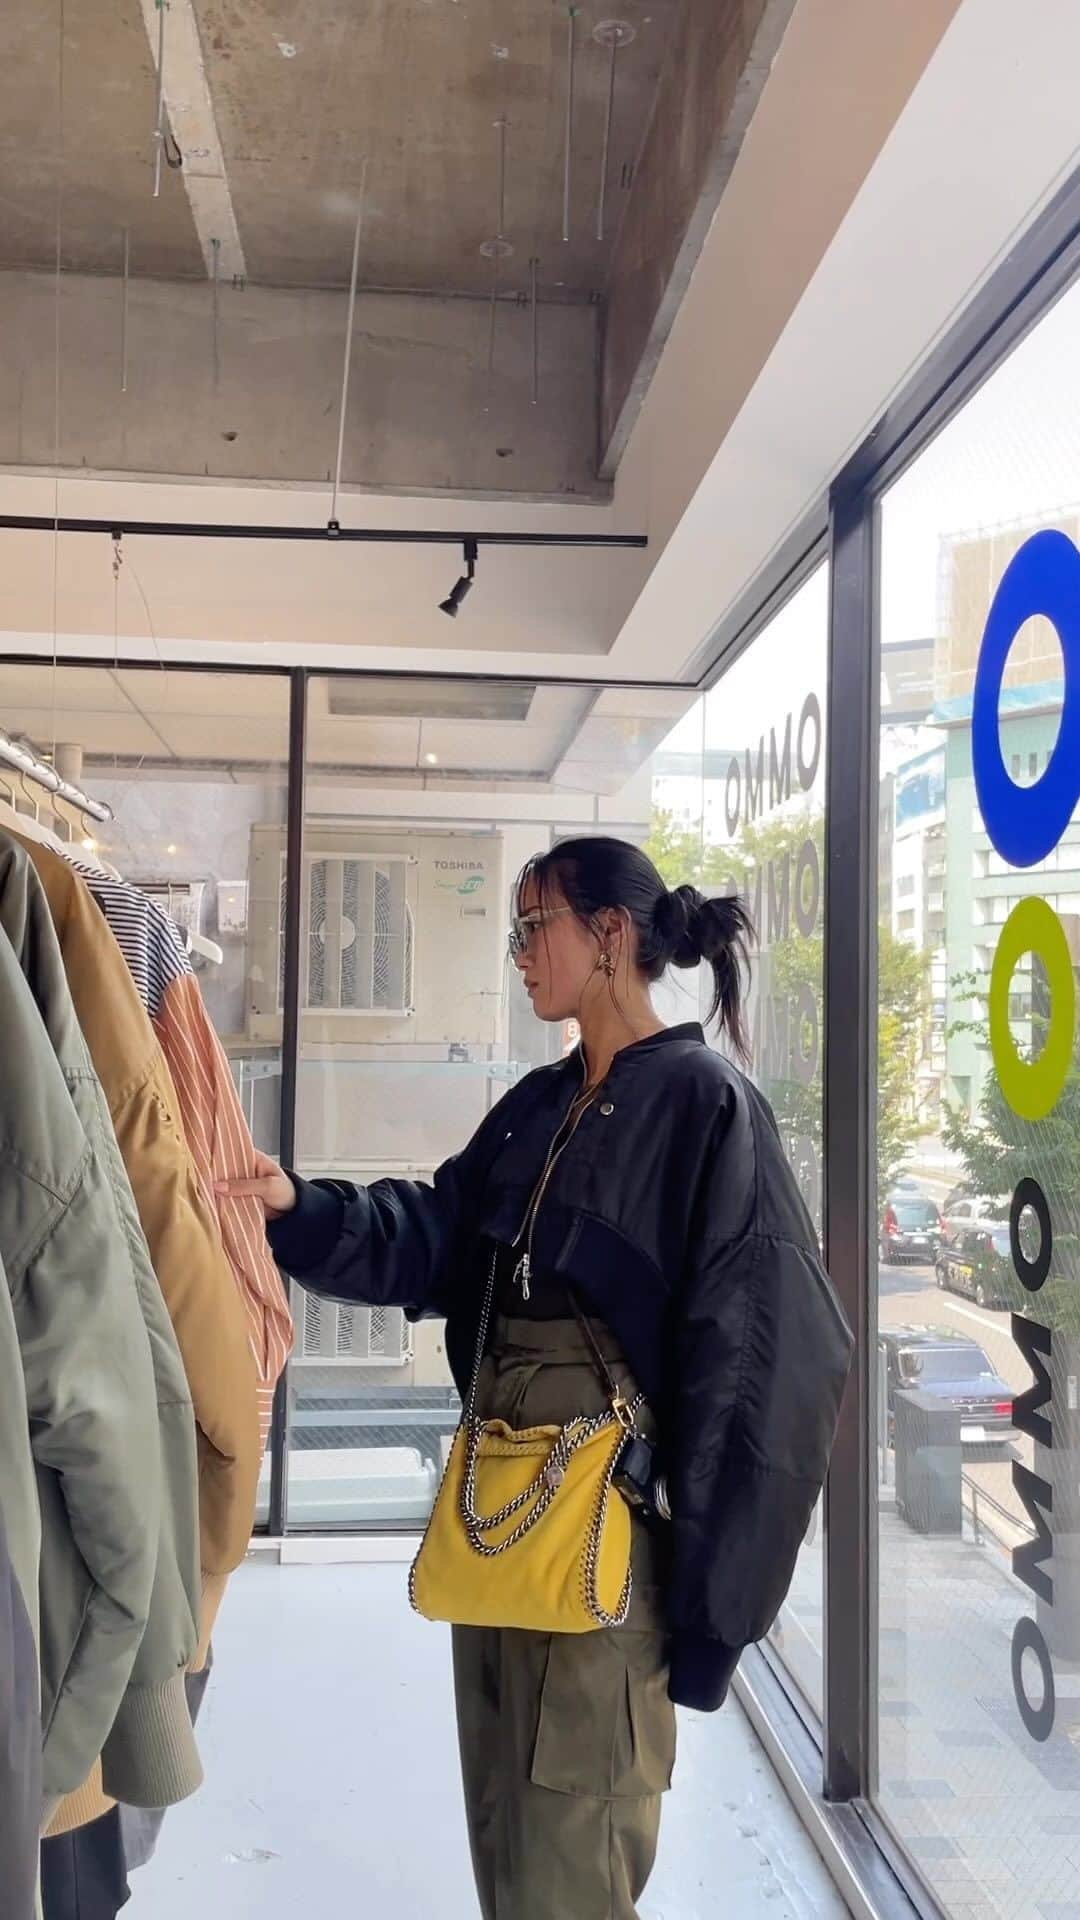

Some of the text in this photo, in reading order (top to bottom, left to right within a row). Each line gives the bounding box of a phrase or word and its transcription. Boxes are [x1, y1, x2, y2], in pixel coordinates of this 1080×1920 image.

[725, 692, 821, 838] OMMO
[434, 860, 484, 870] TOSHIBA
[989, 896, 1075, 1121] O
[1009, 1177, 1055, 1742] OMMO
